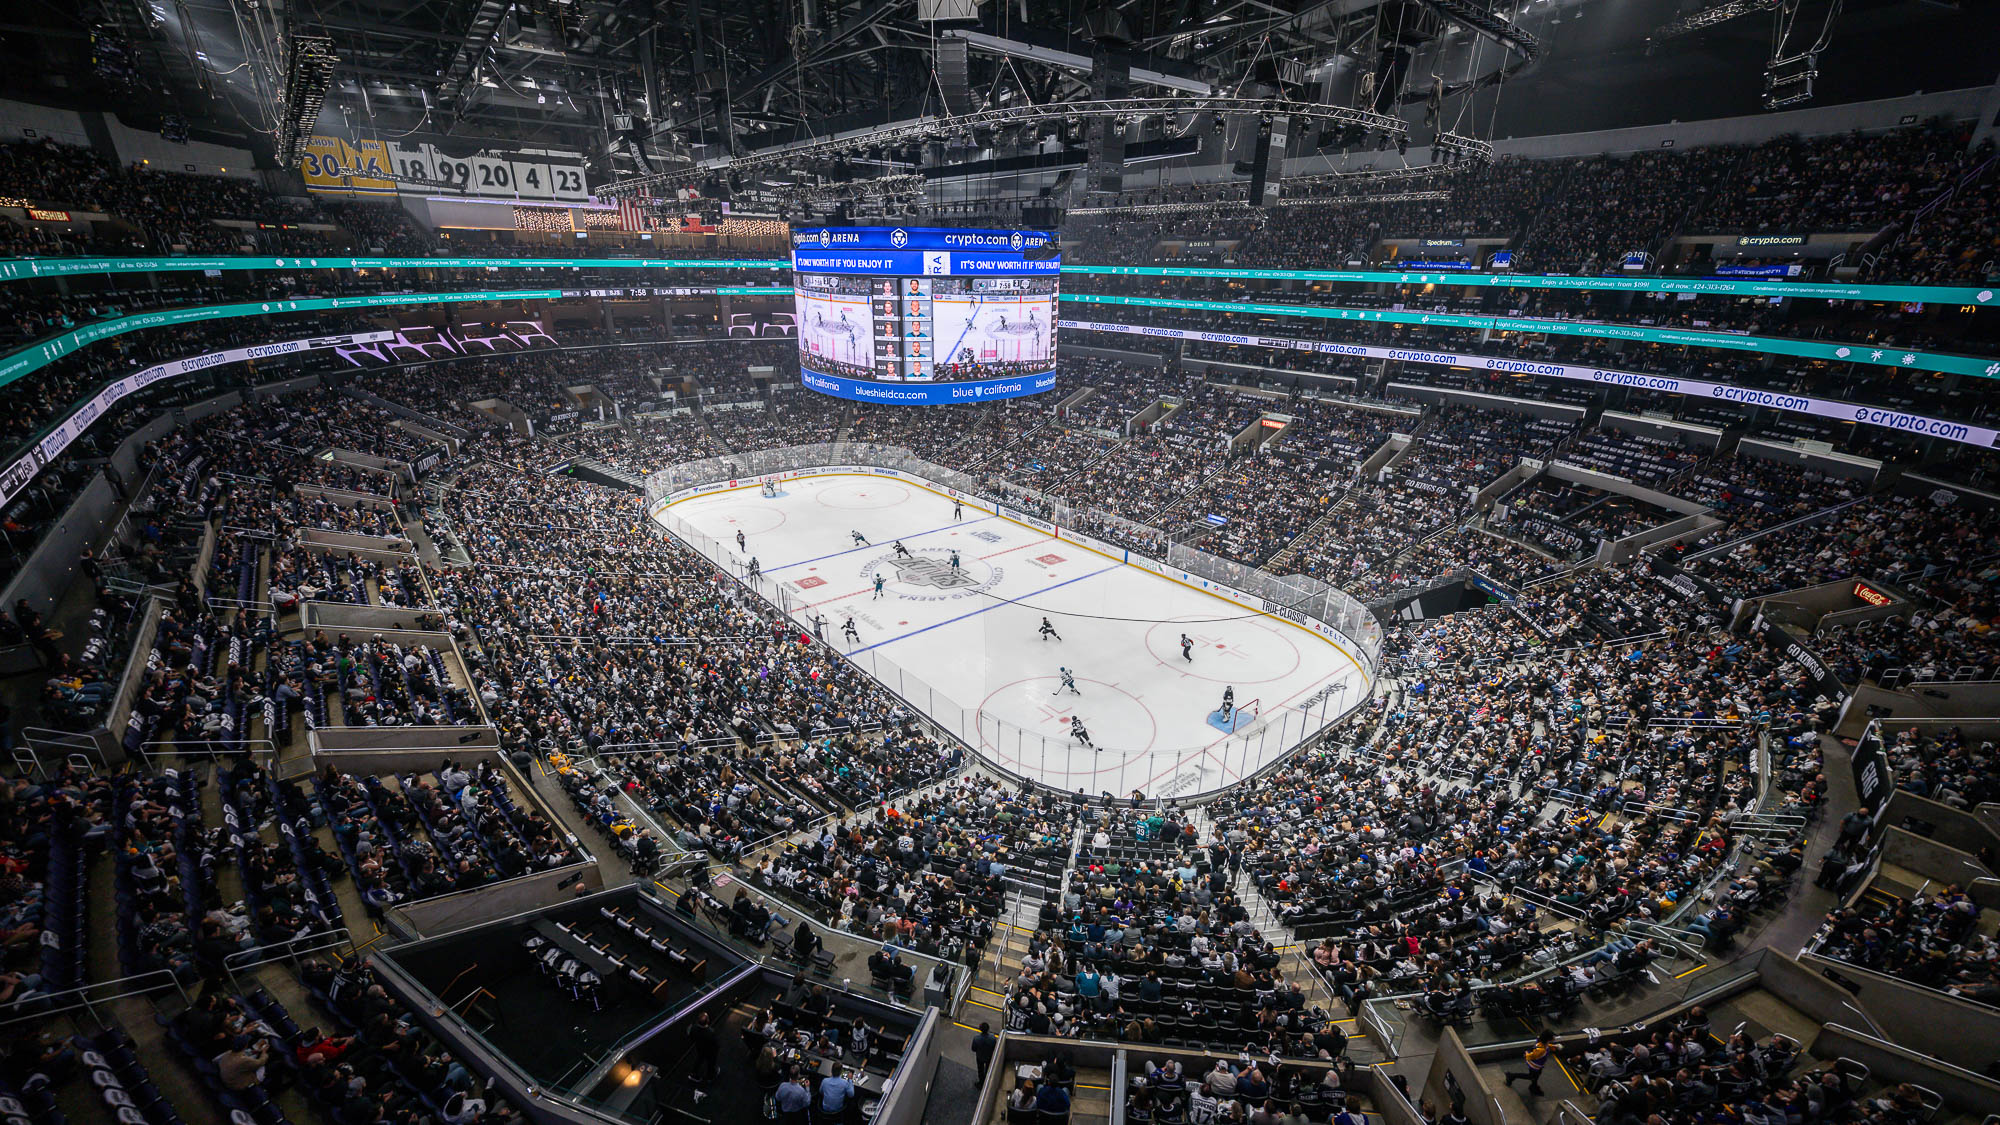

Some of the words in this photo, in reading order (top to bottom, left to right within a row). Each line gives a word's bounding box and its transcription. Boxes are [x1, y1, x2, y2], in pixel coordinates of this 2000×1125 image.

[303, 152, 341, 178] 30
[355, 155, 384, 177] 16
[399, 158, 428, 180] 18
[439, 160, 471, 188] 99
[479, 164, 509, 188] 20
[526, 168, 540, 190] 4
[557, 170, 583, 193] 23
[33, 209, 70, 221] TOSHIBA
[832, 233, 860, 243] ARENA
[945, 233, 1008, 249] crypto.com
[1749, 236, 1802, 246] crypto.com
[843, 259, 857, 268] YOU
[858, 259, 883, 269] ENJOY
[885, 260, 894, 269] IT
[961, 259, 975, 270] IT'S
[976, 260, 995, 270] ONLY
[996, 260, 1022, 270] WORTH
[1022, 261, 1028, 270] IT
[1028, 261, 1034, 270] IF
[1034, 261, 1045, 270] YOU
[630, 288, 647, 297] 7:58
[1095, 321, 1130, 332] crypto.com
[1147, 328, 1183, 338] crypto.com
[1207, 332, 1248, 345] crypto.com
[255, 341, 299, 359] crypto.com
[1320, 343, 1367, 356] rypto.com
[1396, 350, 1457, 366] crypto.com
[187, 353, 226, 371] crypto.com
[1496, 361, 1565, 377] crypto.com
[139, 366, 167, 387] crypto.com
[815, 376, 840, 393] california
[1603, 371, 1679, 392] crypto.com
[856, 385, 928, 401] blueshieldca.com
[952, 387, 974, 398] blue
[984, 382, 1022, 396] california
[1725, 387, 1809, 412] crypto.com
[1870, 409, 1969, 441] crypto.com
[42, 428, 69, 458] rypto.com
[37, 453, 45, 465] 3
[1405, 478, 1415, 488] GO
[1415, 481, 1436, 493] KINGS
[1436, 485, 1447, 495] GO
[1027, 516, 1051, 530] Spectrum
[1859, 587, 1882, 605] Coca-Cola
[1262, 600, 1279, 613] TRUE
[1279, 607, 1308, 626] CLASSIC
[1323, 627, 1347, 646] DELTA
[1786, 643, 1799, 657] GO
[1797, 650, 1819, 674] KINGS
[1812, 667, 1825, 681] GO
[1861, 760, 1879, 799] GKG
[1136, 828, 1146, 837] 39
[899, 840, 910, 849] 22
[1196, 1107, 1212, 1124] 17
